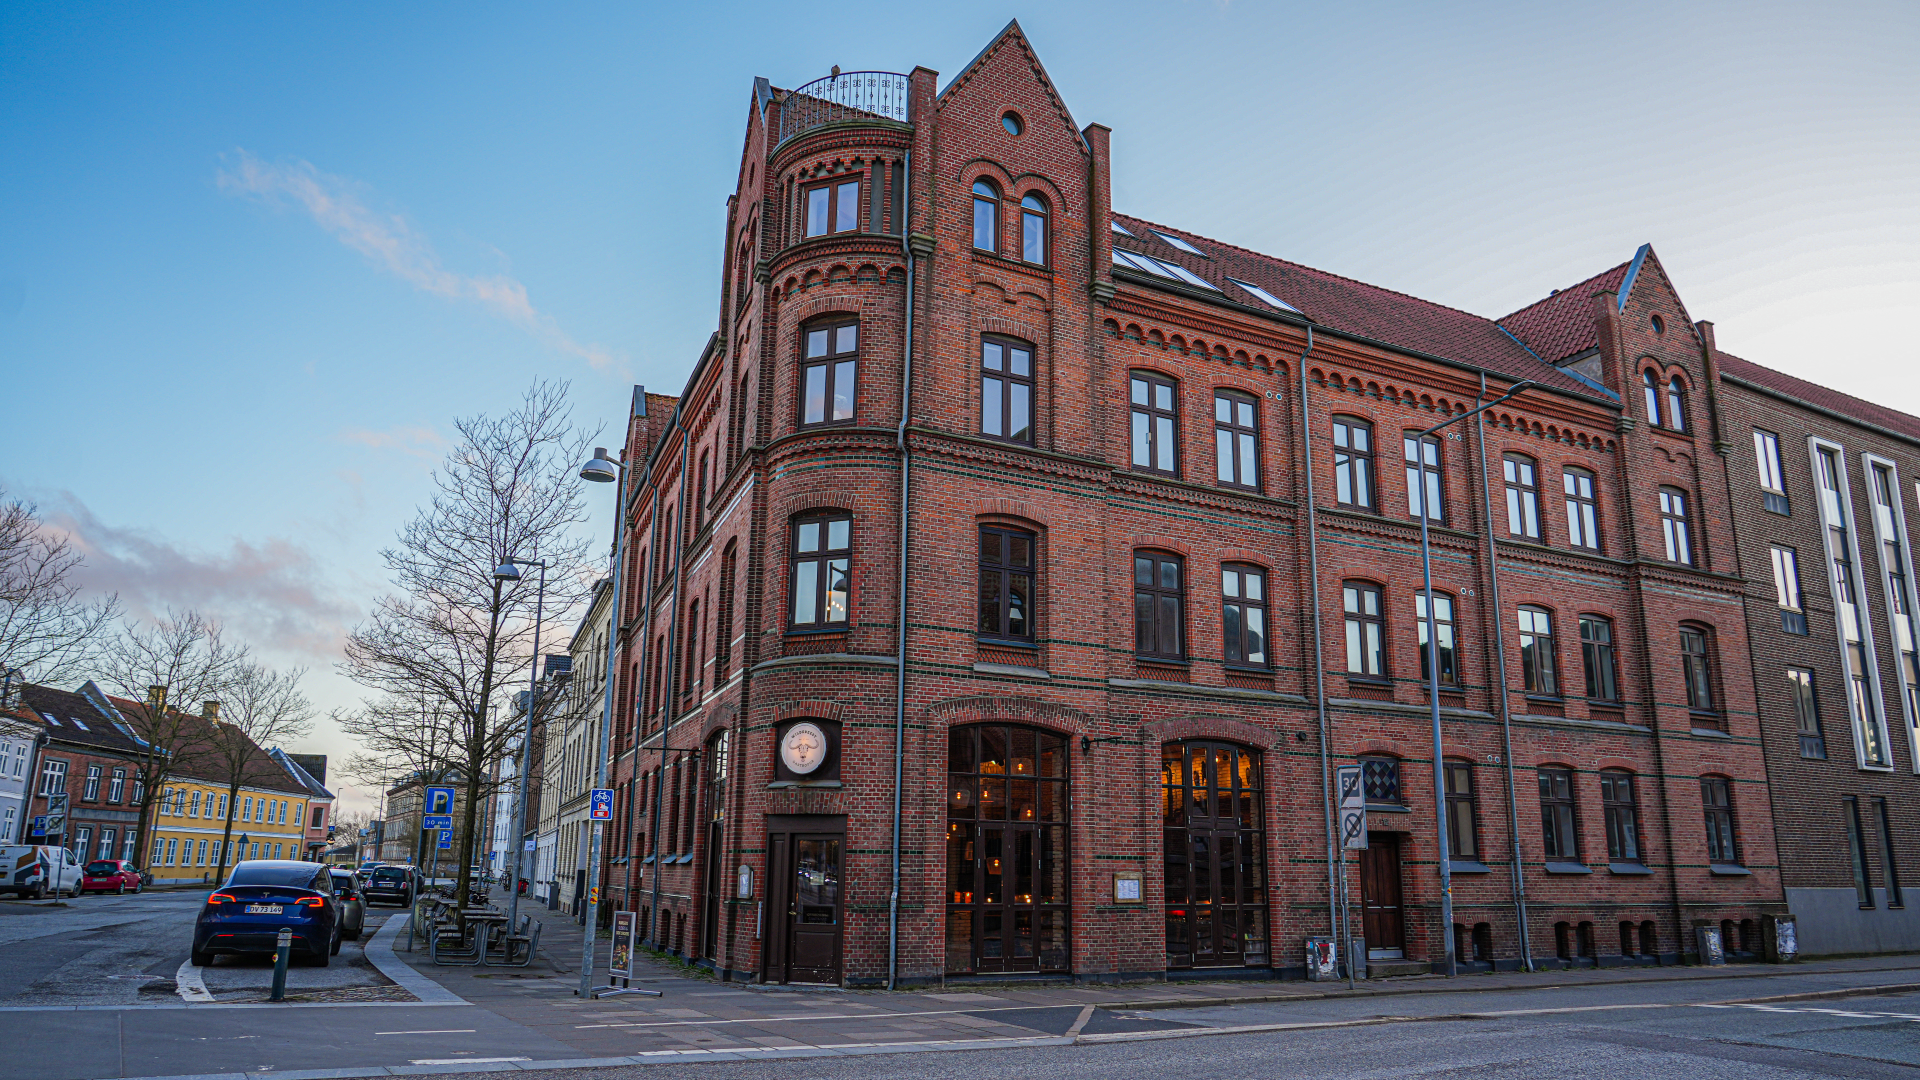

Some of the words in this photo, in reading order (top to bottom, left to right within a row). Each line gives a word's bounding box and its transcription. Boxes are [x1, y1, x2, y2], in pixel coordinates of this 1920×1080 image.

[1343, 777, 1358, 791] 30
[433, 790, 449, 811] P
[36, 817, 46, 827] P
[441, 831, 450, 841] P
